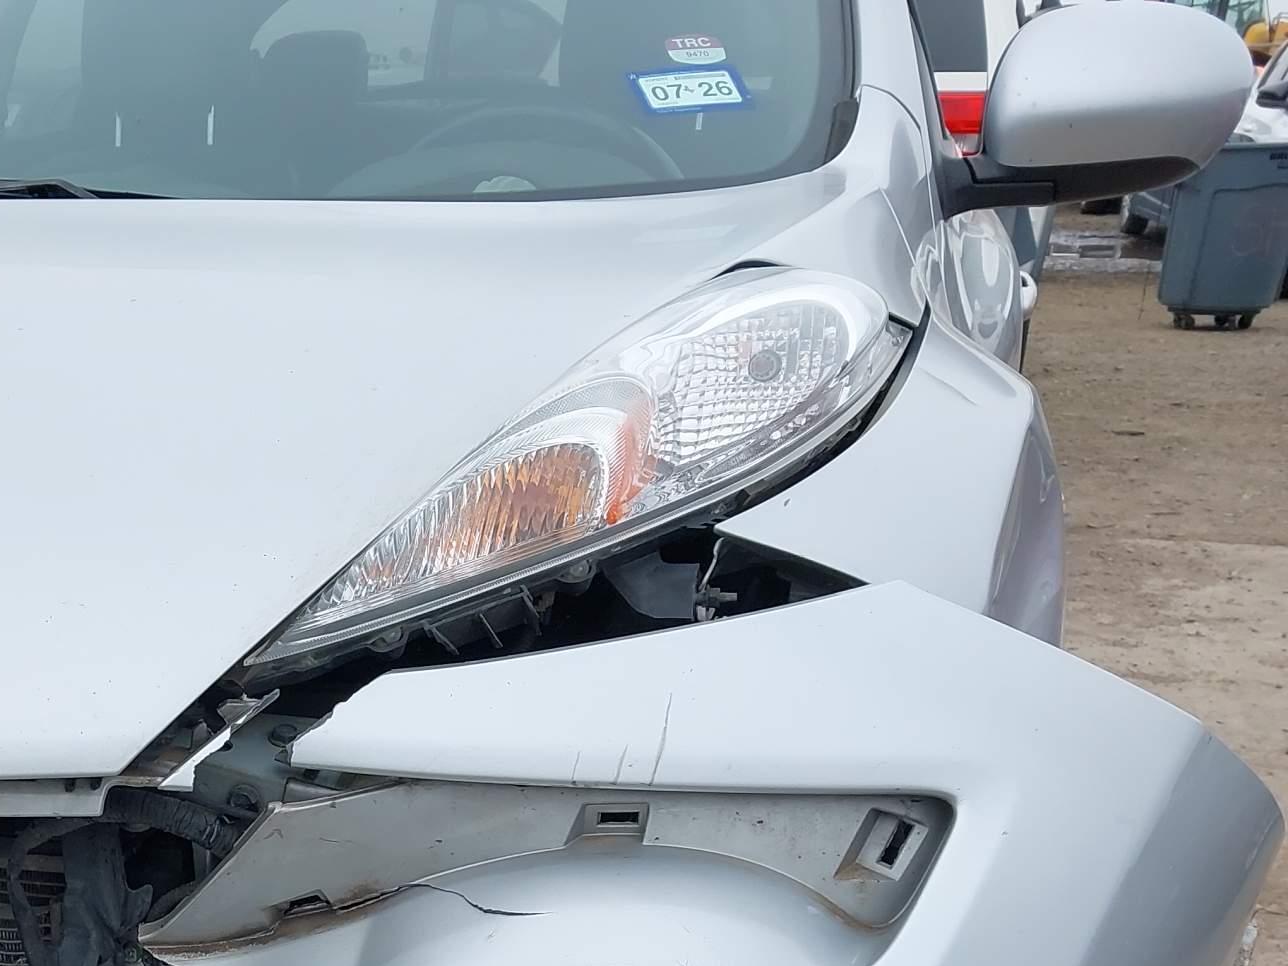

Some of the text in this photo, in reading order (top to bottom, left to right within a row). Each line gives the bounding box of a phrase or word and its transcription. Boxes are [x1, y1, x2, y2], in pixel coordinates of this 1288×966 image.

[672, 37, 711, 48] TRC
[651, 80, 733, 101] 07 26
